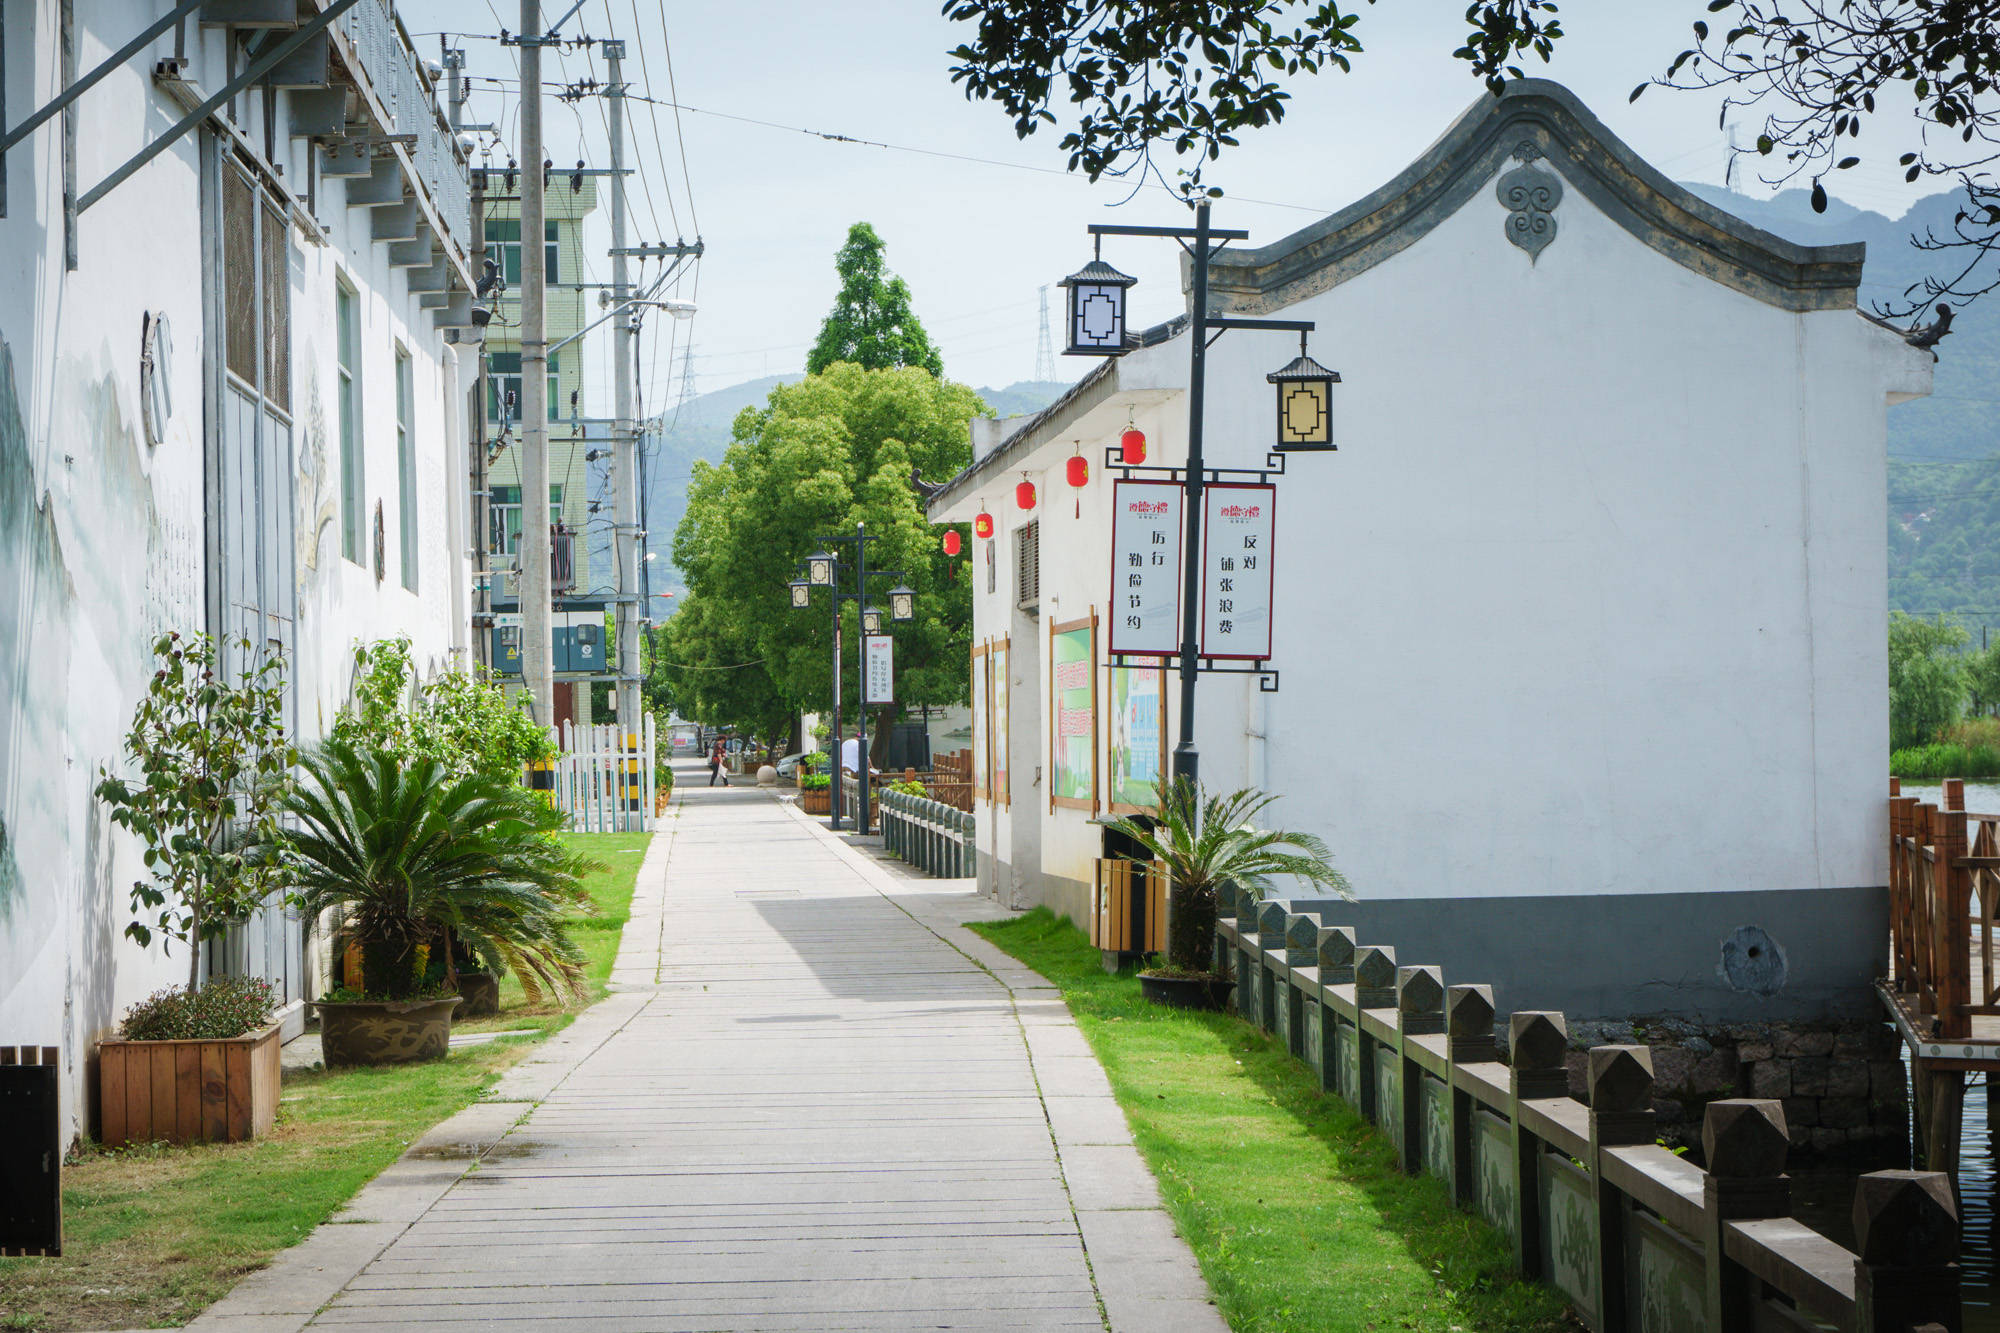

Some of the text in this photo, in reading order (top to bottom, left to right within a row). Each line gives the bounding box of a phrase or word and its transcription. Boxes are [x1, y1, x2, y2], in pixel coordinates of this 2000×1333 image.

[1152, 530, 1165, 565] 厉行
[1243, 535, 1257, 570] 反对
[1127, 552, 1143, 629] 勤俭节约
[1219, 557, 1234, 634] 铺张浪费
